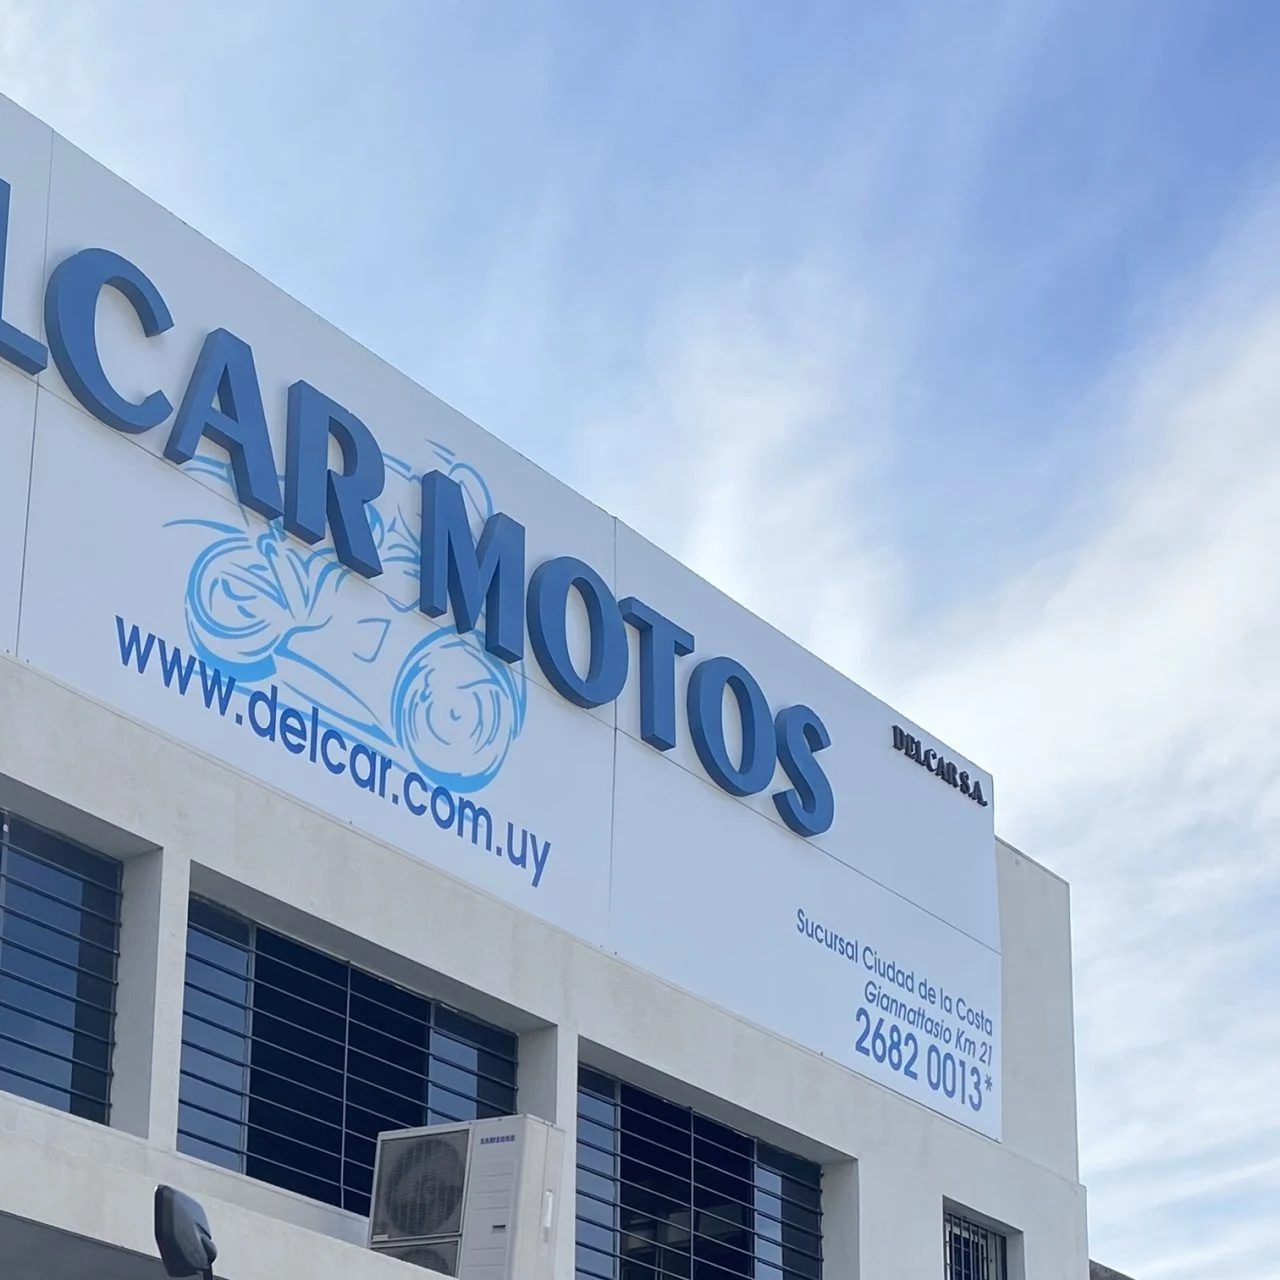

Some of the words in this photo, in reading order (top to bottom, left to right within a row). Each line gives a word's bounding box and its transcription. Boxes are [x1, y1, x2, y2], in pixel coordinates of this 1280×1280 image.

[421, 469, 835, 838] MOTOS
[115, 615, 552, 888] www.delcar.com.uy
[892, 725, 959, 788] DELCAR
[796, 908, 859, 963] Sucursal
[862, 946, 914, 991] Ciudad
[918, 979, 936, 1001] de
[940, 987, 953, 1009] la
[956, 998, 993, 1037] Costa
[855, 1008, 919, 1080] 2682
[864, 981, 952, 1045] Giannattasio
[955, 1027, 977, 1058] Km
[980, 1039, 993, 1066] 21
[479, 1134, 516, 1145] SAMSUNG
